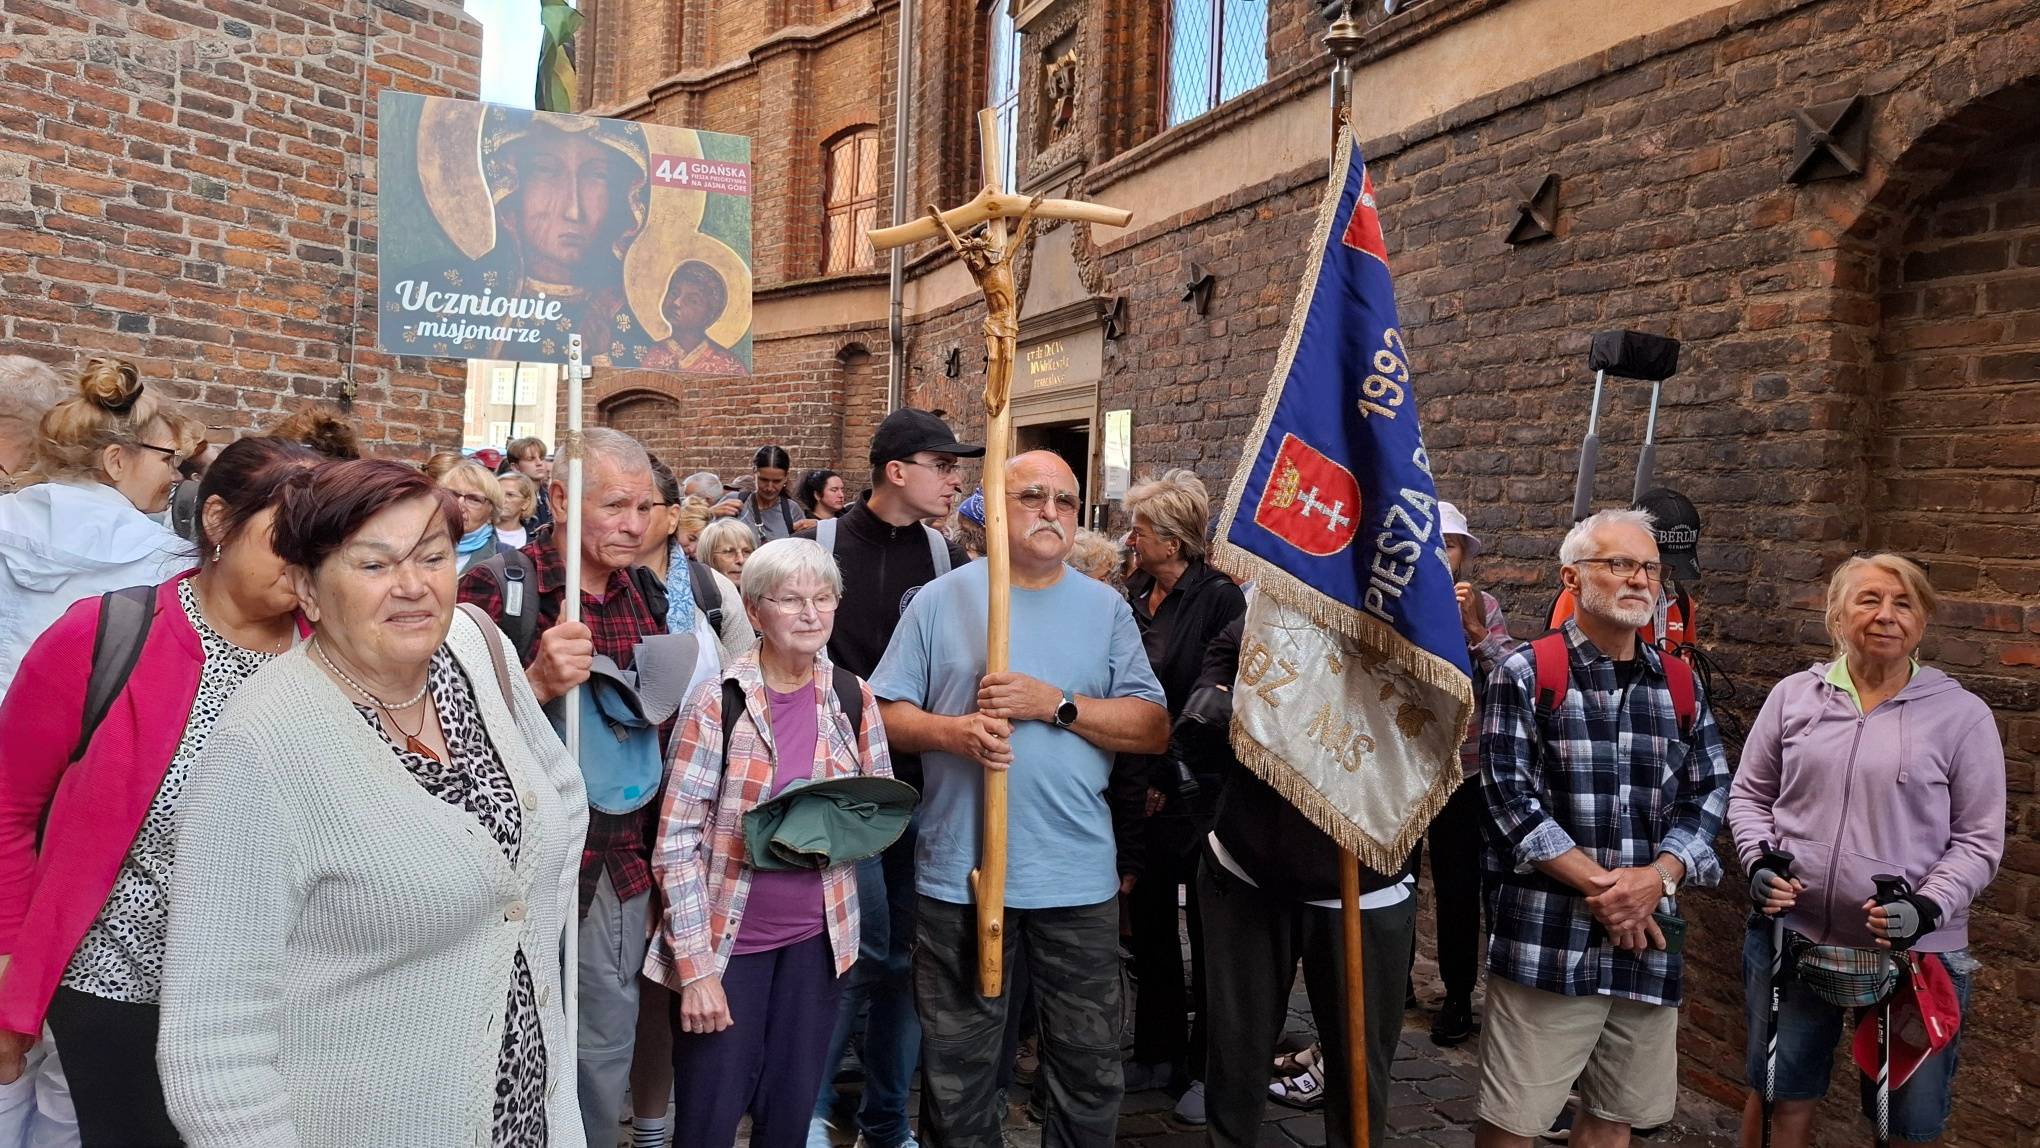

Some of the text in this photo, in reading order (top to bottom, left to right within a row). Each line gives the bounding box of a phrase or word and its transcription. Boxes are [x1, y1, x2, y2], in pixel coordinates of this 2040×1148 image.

[655, 159, 689, 185] 44
[691, 163, 746, 178] GDAŃSKA
[394, 280, 563, 321] Uczniowie
[417, 317, 541, 345] misjonarze
[1658, 529, 1698, 544] BERLIN
[1364, 487, 1438, 624] PIESZA
